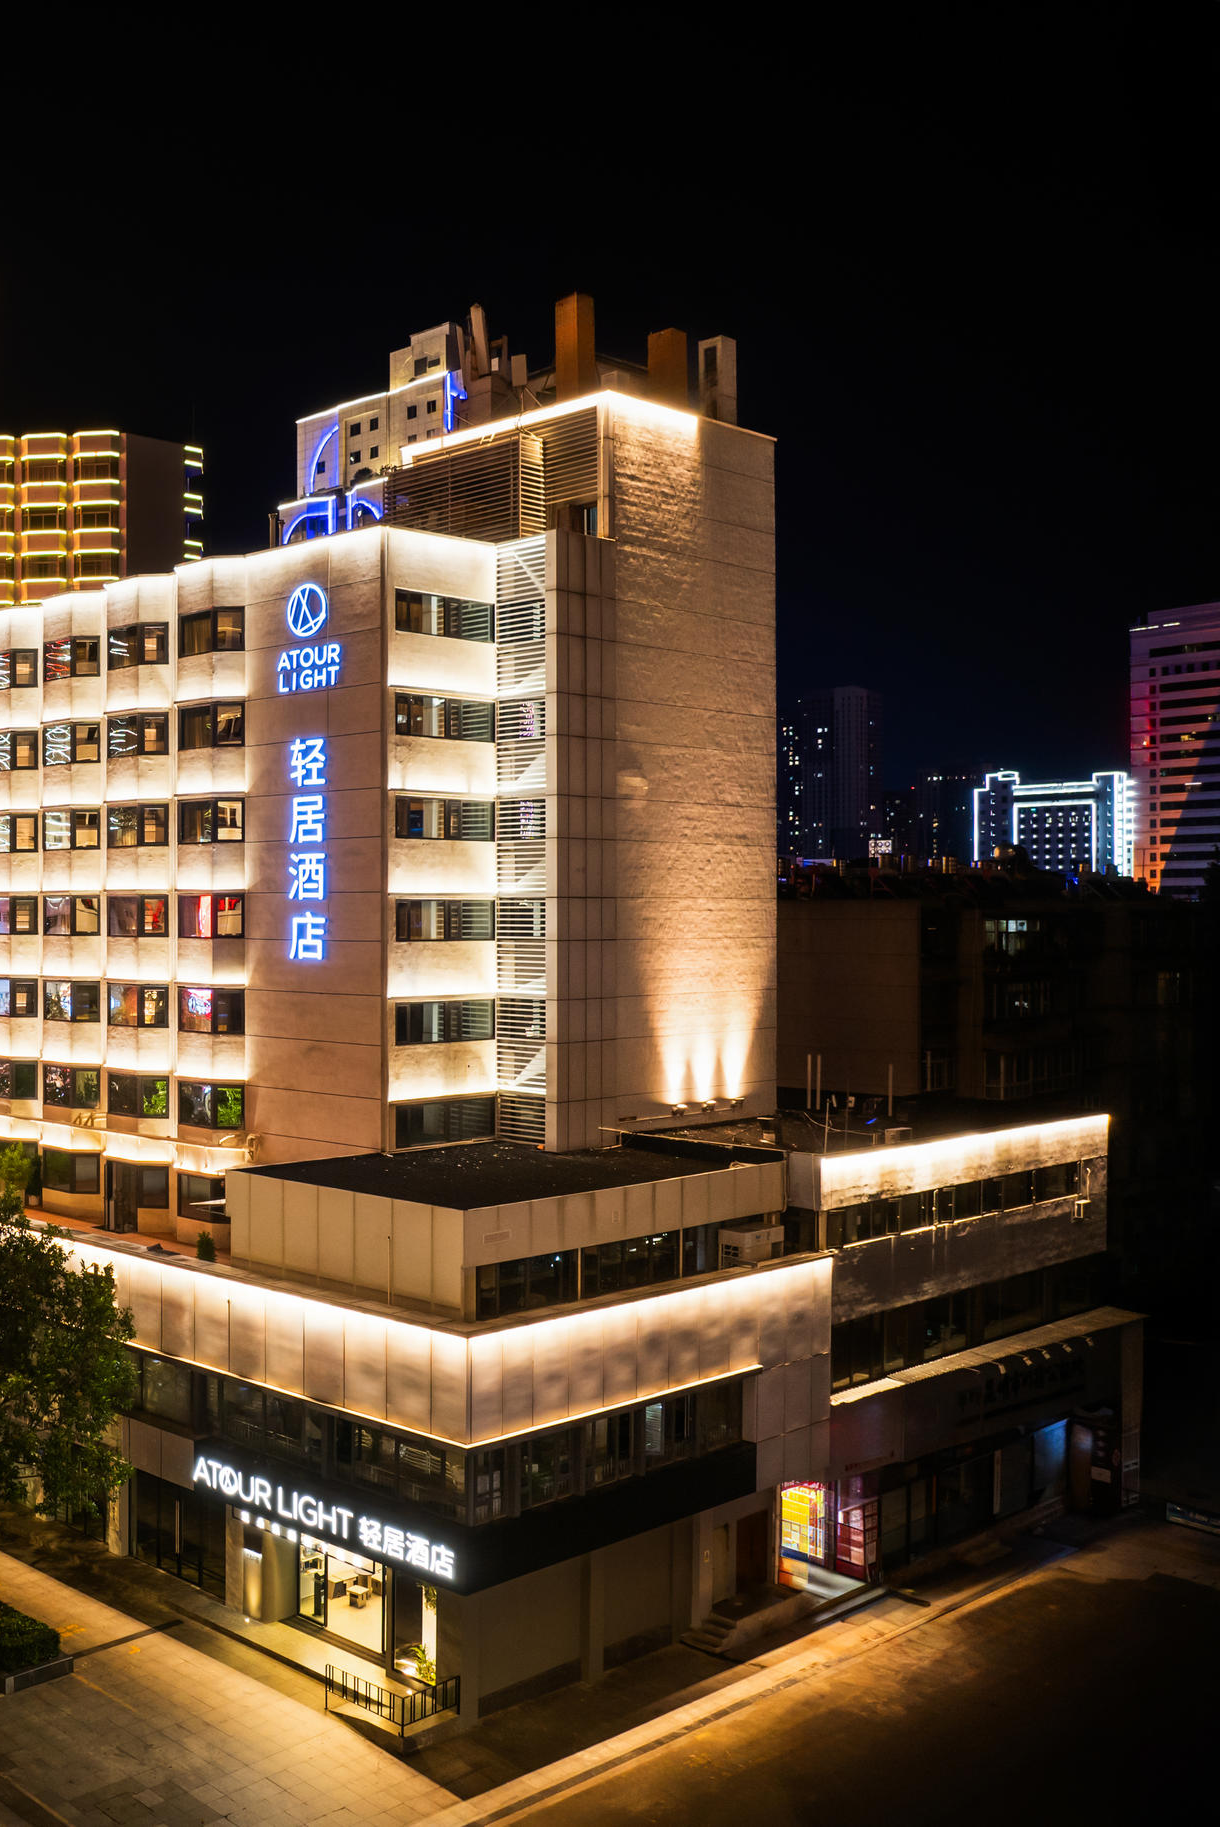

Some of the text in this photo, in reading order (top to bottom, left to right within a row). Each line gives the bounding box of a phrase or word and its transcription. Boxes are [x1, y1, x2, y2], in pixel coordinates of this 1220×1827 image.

[277, 644, 340, 671] ATOUR
[279, 666, 340, 692] LIGHT
[289, 737, 327, 960] 轻居酒店
[193, 1456, 455, 1580] ATOUR LIGHT 轻居酒店
